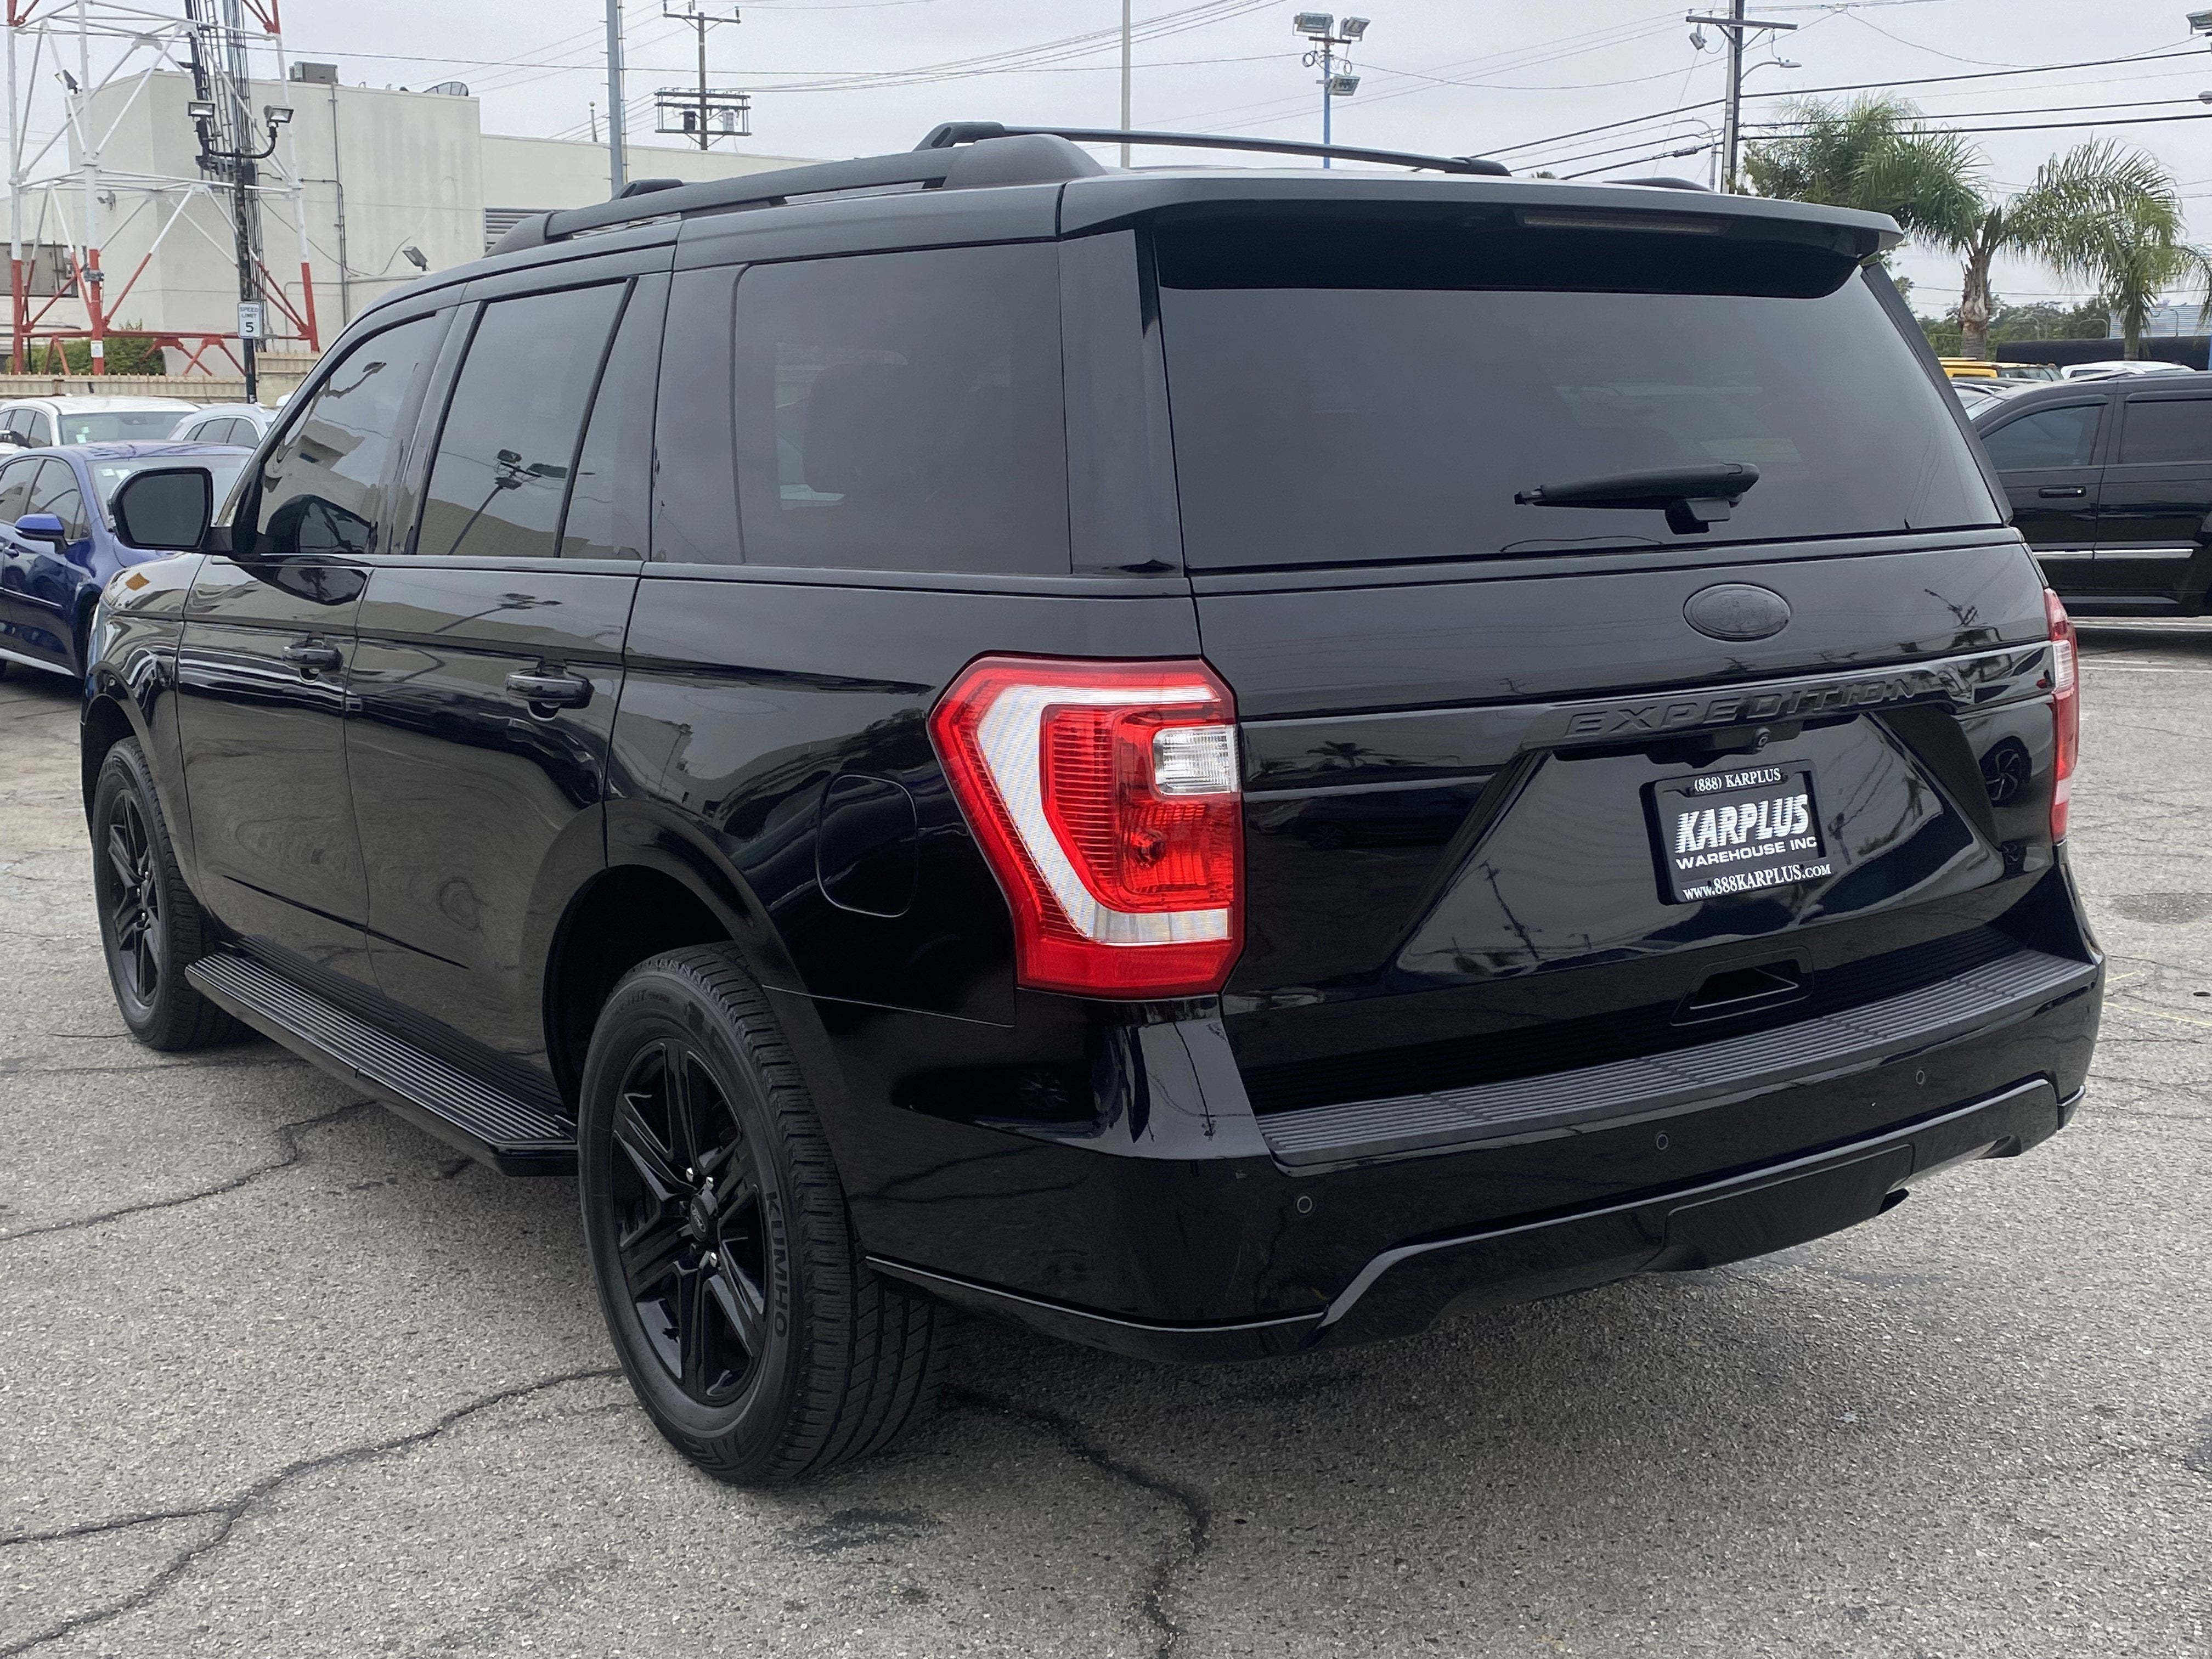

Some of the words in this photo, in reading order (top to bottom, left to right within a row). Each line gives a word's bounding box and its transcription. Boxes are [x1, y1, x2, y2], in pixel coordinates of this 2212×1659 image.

[245, 321, 254, 332] 5
[1564, 676, 1921, 738] EXPEDITION
[1694, 776, 1722, 792] (888)
[1725, 768, 1781, 788] KARPLUS
[1674, 794, 1809, 854] KARPLUS
[1675, 842, 1786, 870] WAREHOUSE
[1790, 836, 1817, 851] INC
[766, 1190, 788, 1339] KUMHO
